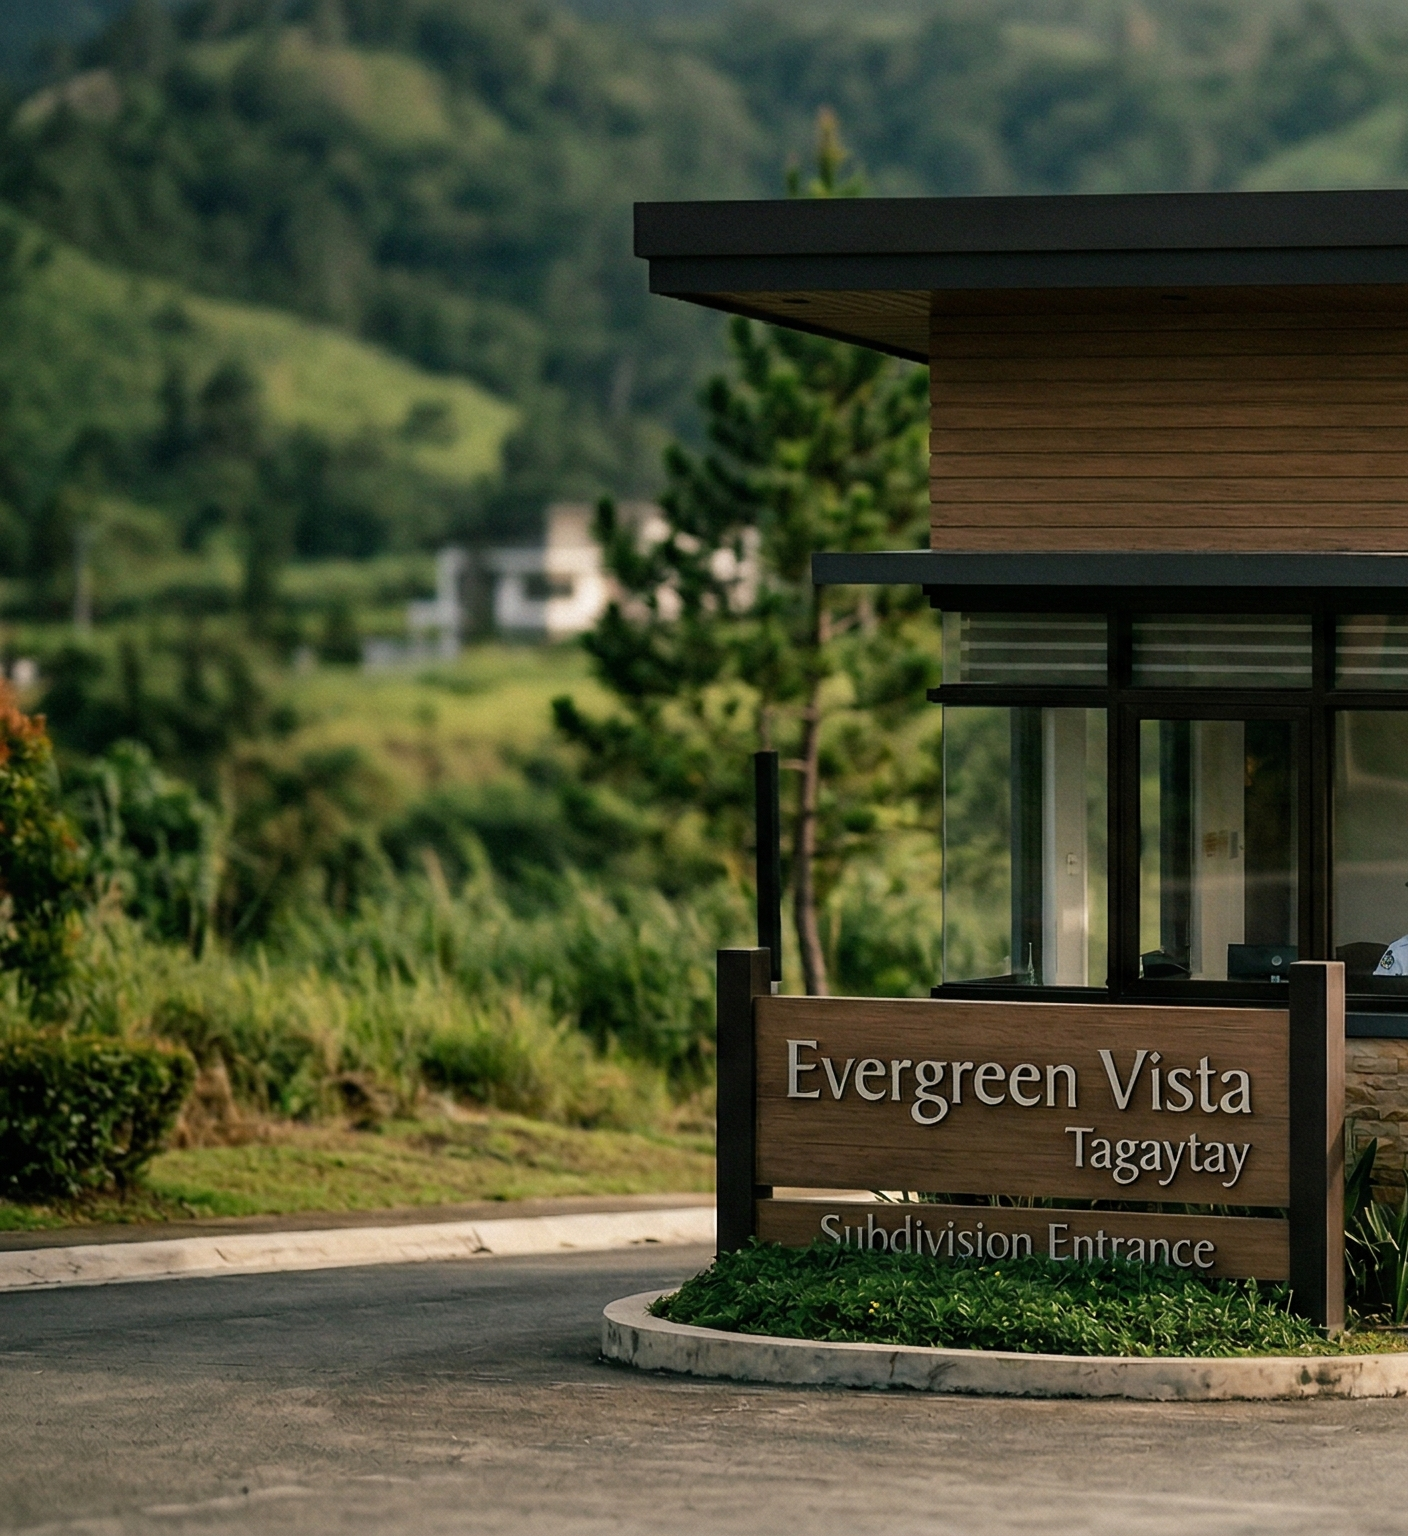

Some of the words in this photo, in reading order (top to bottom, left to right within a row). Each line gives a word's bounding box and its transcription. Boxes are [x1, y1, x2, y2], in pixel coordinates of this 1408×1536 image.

[786, 1039, 1077, 1125] Evergreen
[1098, 1049, 1252, 1114] Vista
[1065, 1127, 1251, 1188] Tagaytay
[1048, 1223, 1215, 1268] Entrance
